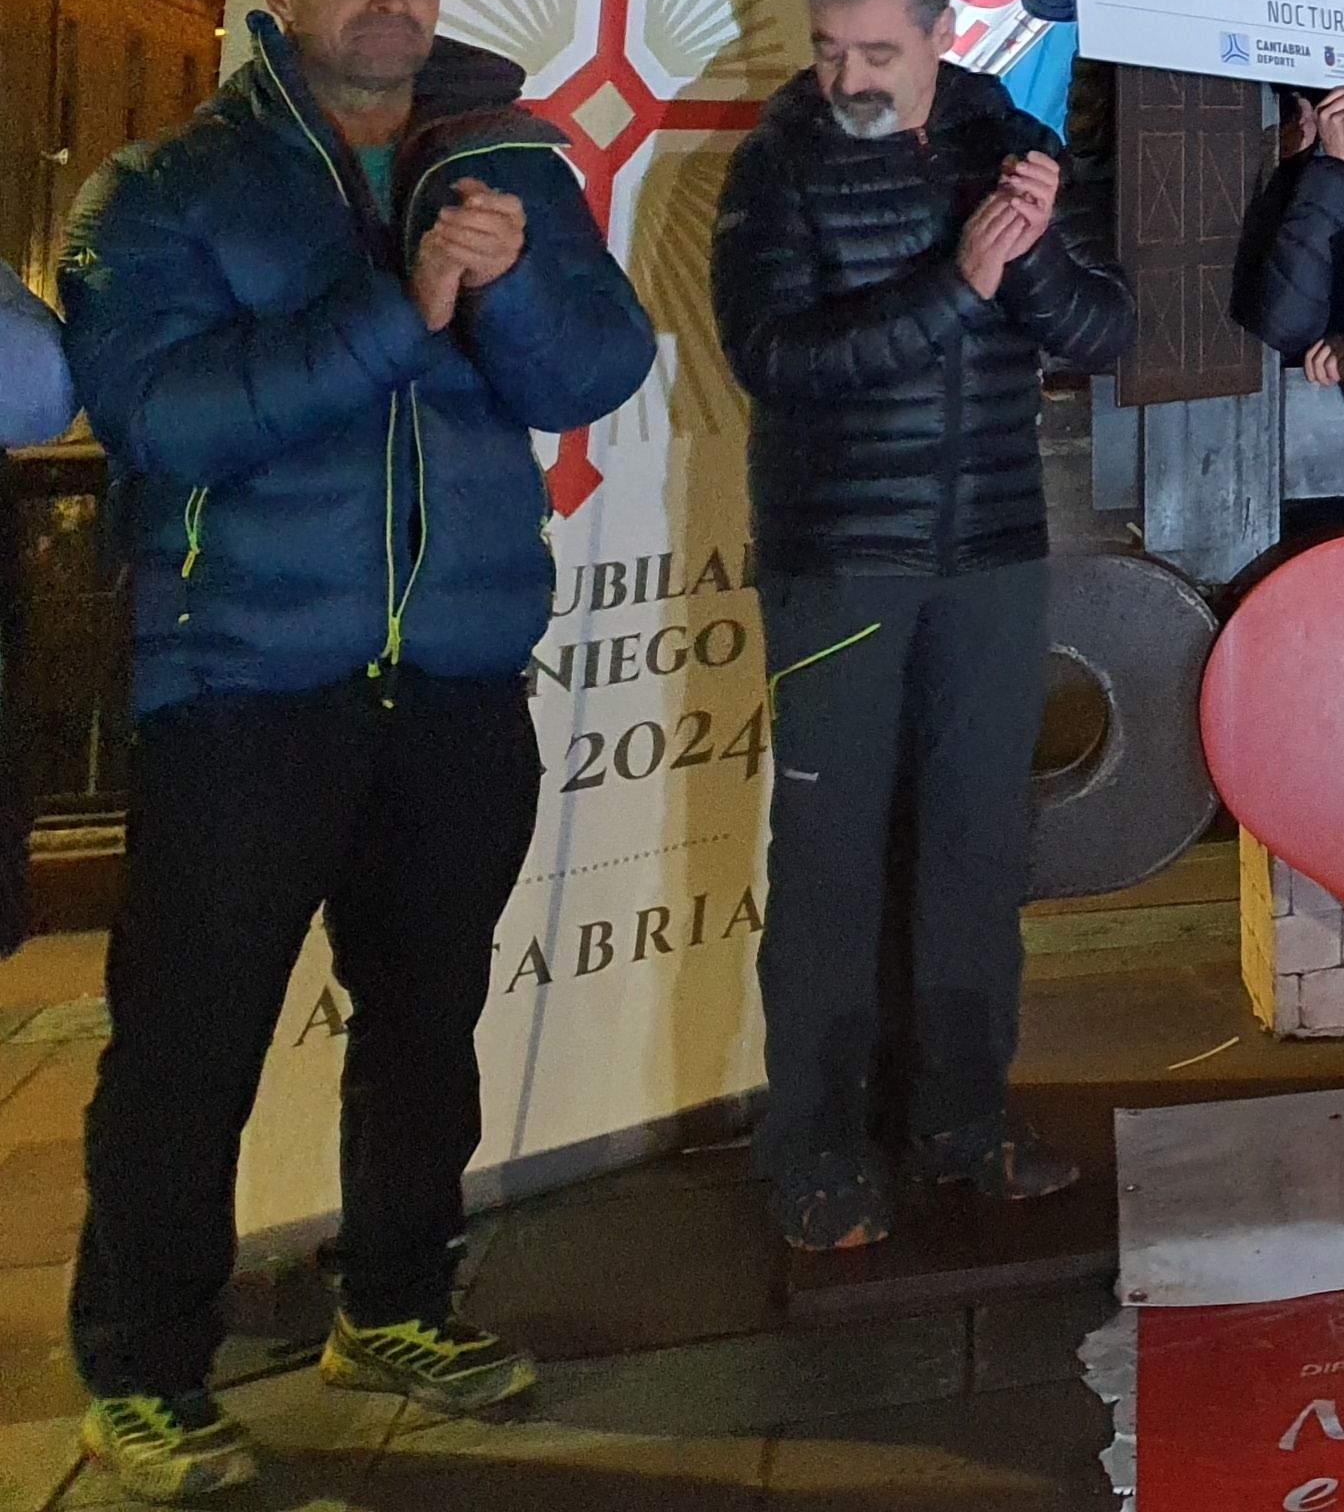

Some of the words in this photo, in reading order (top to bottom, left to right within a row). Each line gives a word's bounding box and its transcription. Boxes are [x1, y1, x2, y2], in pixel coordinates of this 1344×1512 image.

[1256, 39, 1311, 57] CANTABRIA
[1257, 55, 1295, 68] DEPORTE
[552, 543, 758, 618] UBILA
[525, 619, 747, 697] NIEGO
